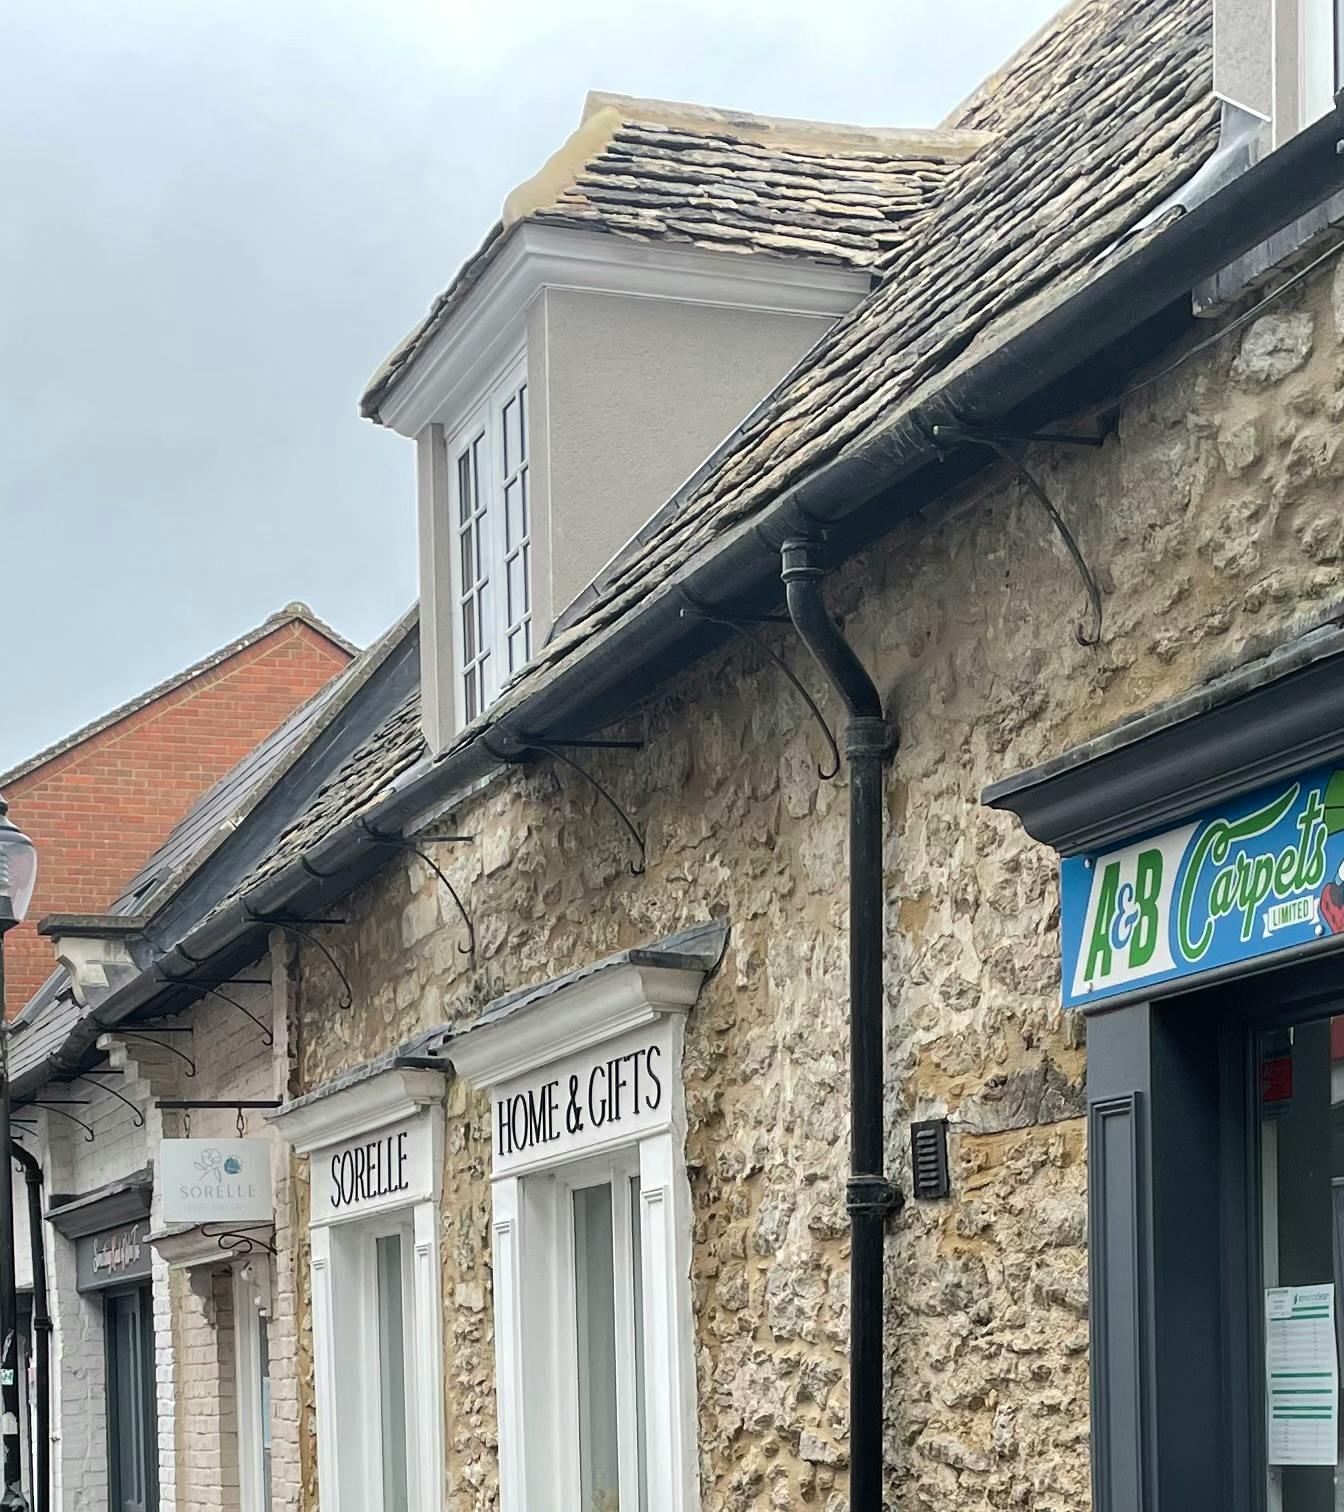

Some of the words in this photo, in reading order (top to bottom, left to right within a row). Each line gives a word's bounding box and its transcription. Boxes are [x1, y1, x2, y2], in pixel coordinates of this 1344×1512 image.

[1083, 847, 1164, 983] A&B
[1177, 782, 1330, 963] Carpets
[1272, 899, 1310, 928] LIMITED
[497, 1081, 561, 1156] HOME
[566, 1074, 584, 1135] &
[588, 1045, 662, 1128] GIFTS
[179, 1184, 257, 1199] SORELLE
[330, 1131, 409, 1208] SORELLE
